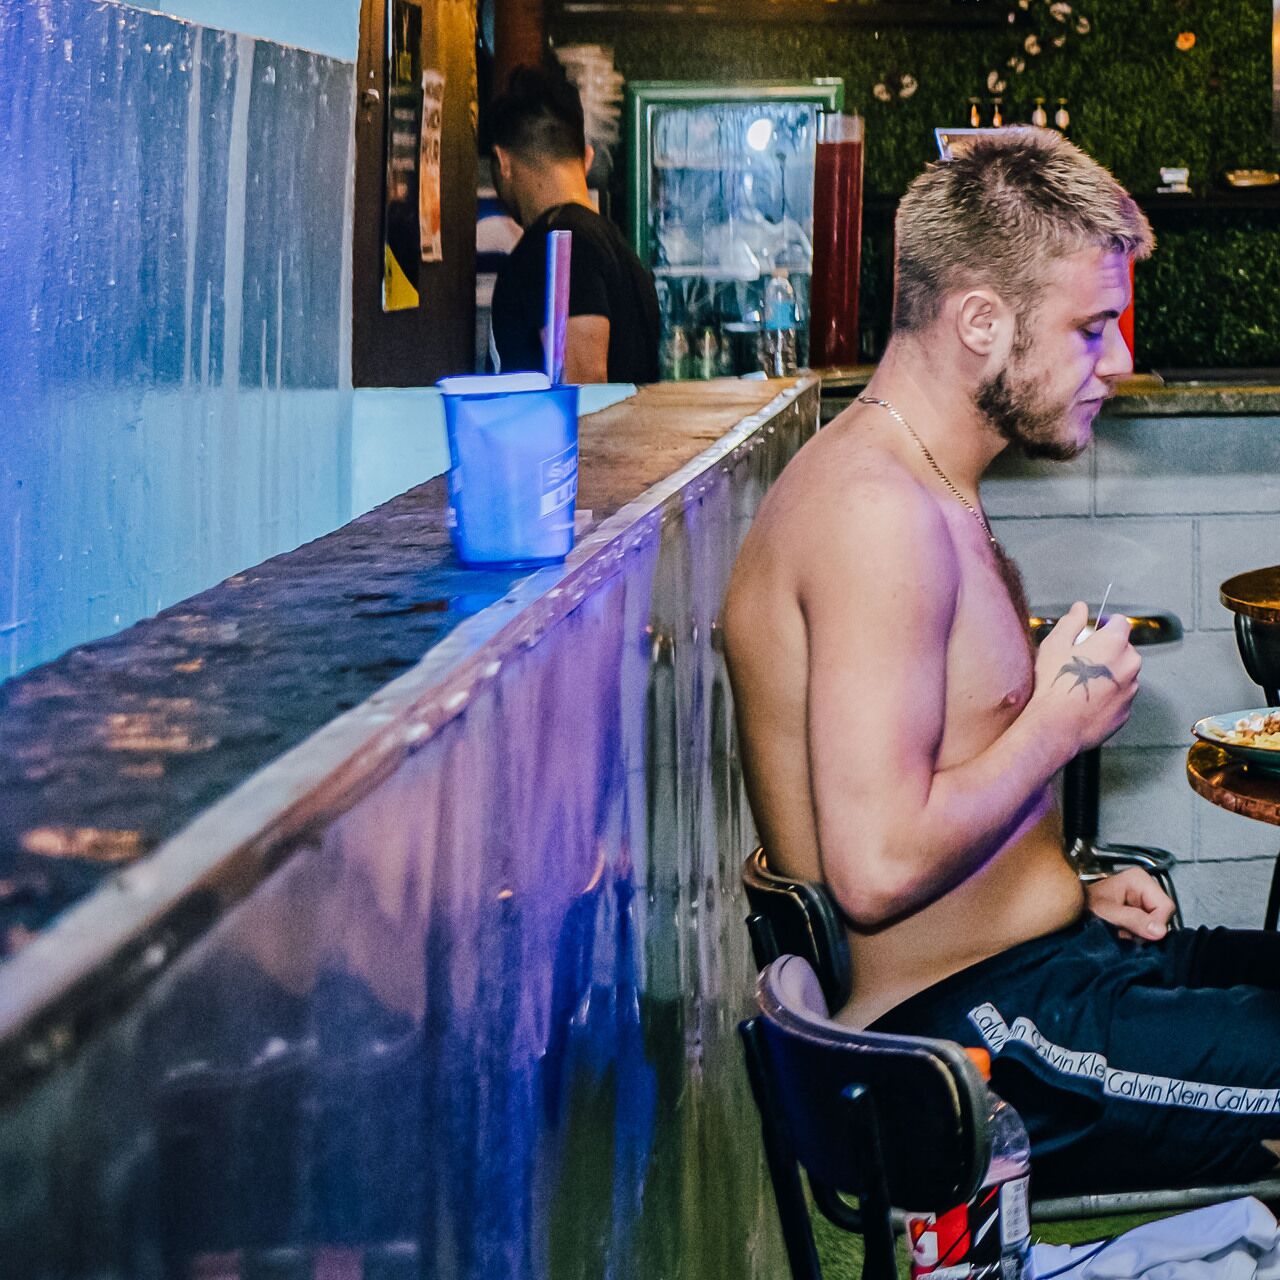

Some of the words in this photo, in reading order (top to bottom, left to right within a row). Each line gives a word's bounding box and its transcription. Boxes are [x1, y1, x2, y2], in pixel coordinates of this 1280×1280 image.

[1031, 1030, 1074, 1071] Calvin
[1077, 1054, 1105, 1078] Kle
[1107, 1071, 1162, 1101] Calvin
[1166, 1079, 1209, 1108] Klein
[1214, 1088, 1269, 1112] Calvin
